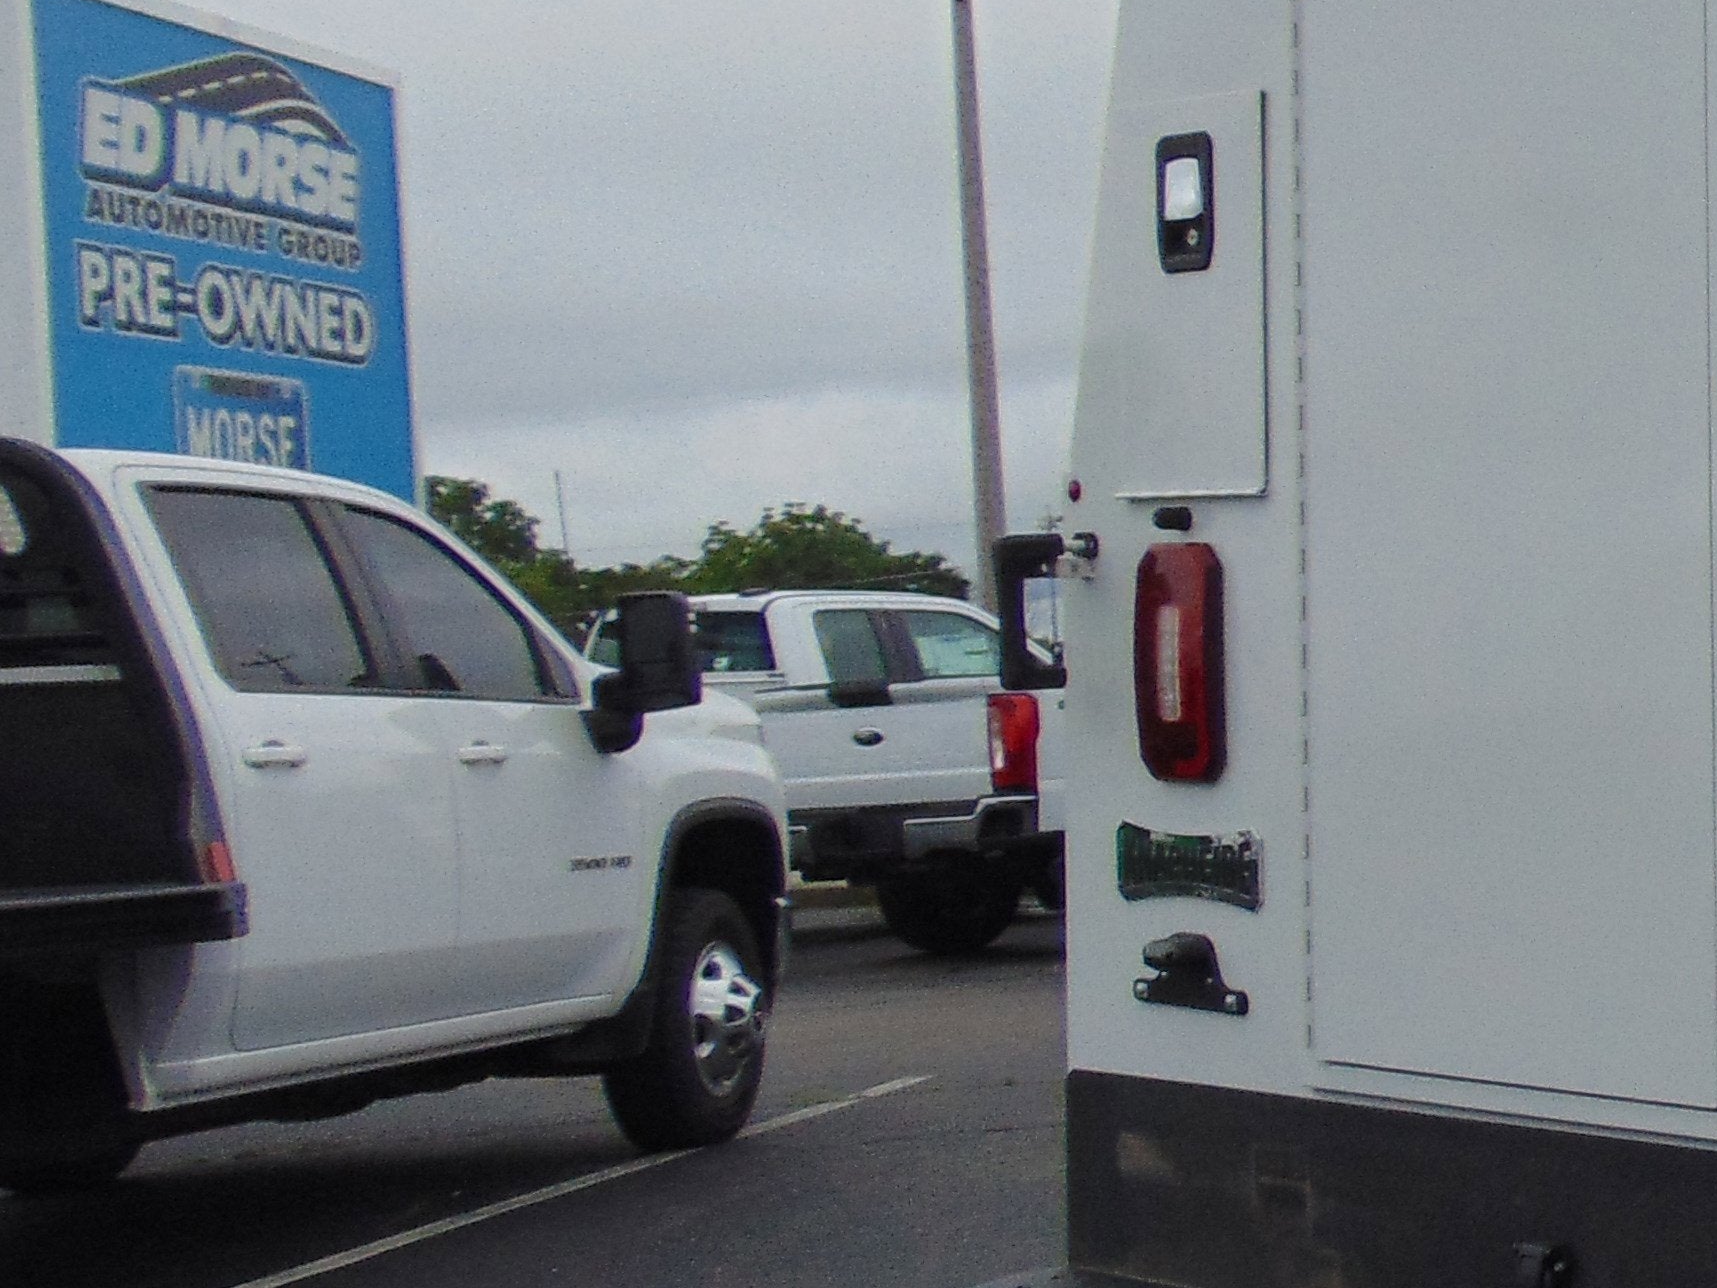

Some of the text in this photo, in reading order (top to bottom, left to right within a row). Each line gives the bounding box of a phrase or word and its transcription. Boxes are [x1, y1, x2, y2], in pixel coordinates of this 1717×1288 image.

[82, 86, 359, 223] ED MORSE
[87, 185, 362, 268] AUTOMOTIVE GROUP
[78, 246, 374, 361] PRE-OWNED
[186, 405, 297, 469] MORSE
